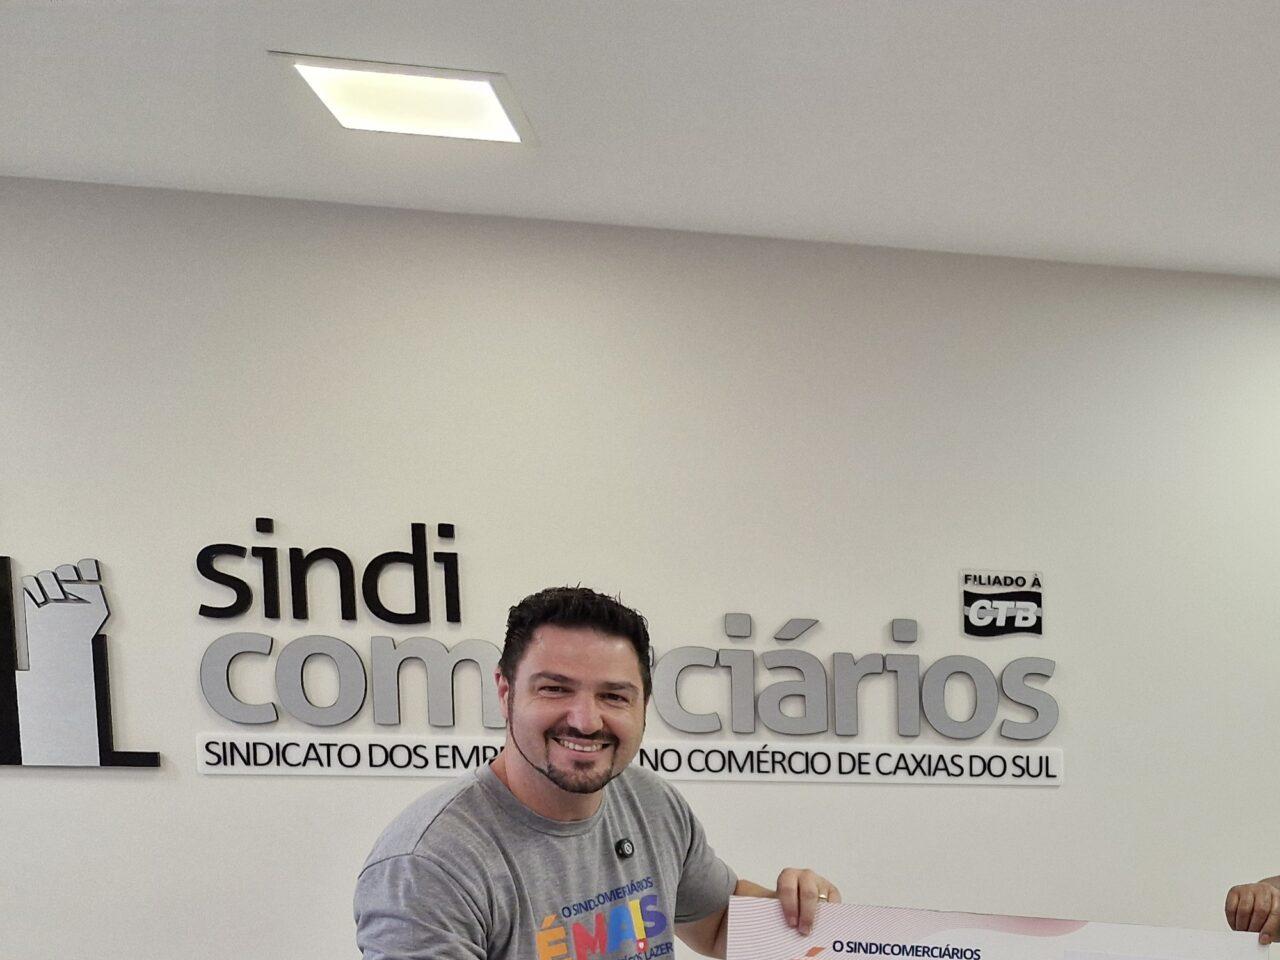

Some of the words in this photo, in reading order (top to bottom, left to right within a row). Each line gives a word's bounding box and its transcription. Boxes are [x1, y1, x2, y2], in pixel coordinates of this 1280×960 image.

[196, 517, 461, 625] sindi
[964, 574, 1027, 587] FILIADO
[968, 599, 1038, 628] CTB
[200, 612, 1059, 740] comciários
[204, 741, 361, 768] SINDICATO
[368, 743, 429, 769] DOS
[639, 748, 682, 773] NO
[687, 744, 831, 775] COMÉRCIO
[838, 752, 871, 775] DE
[875, 753, 964, 777] CAXIAS
[969, 755, 1007, 777] DO
[1012, 755, 1057, 778] SUL
[561, 906, 572, 918] O
[645, 942, 673, 960] LAZER
[832, 940, 844, 952] O
[846, 941, 981, 960] SINDICOMERCIÁRIOS
